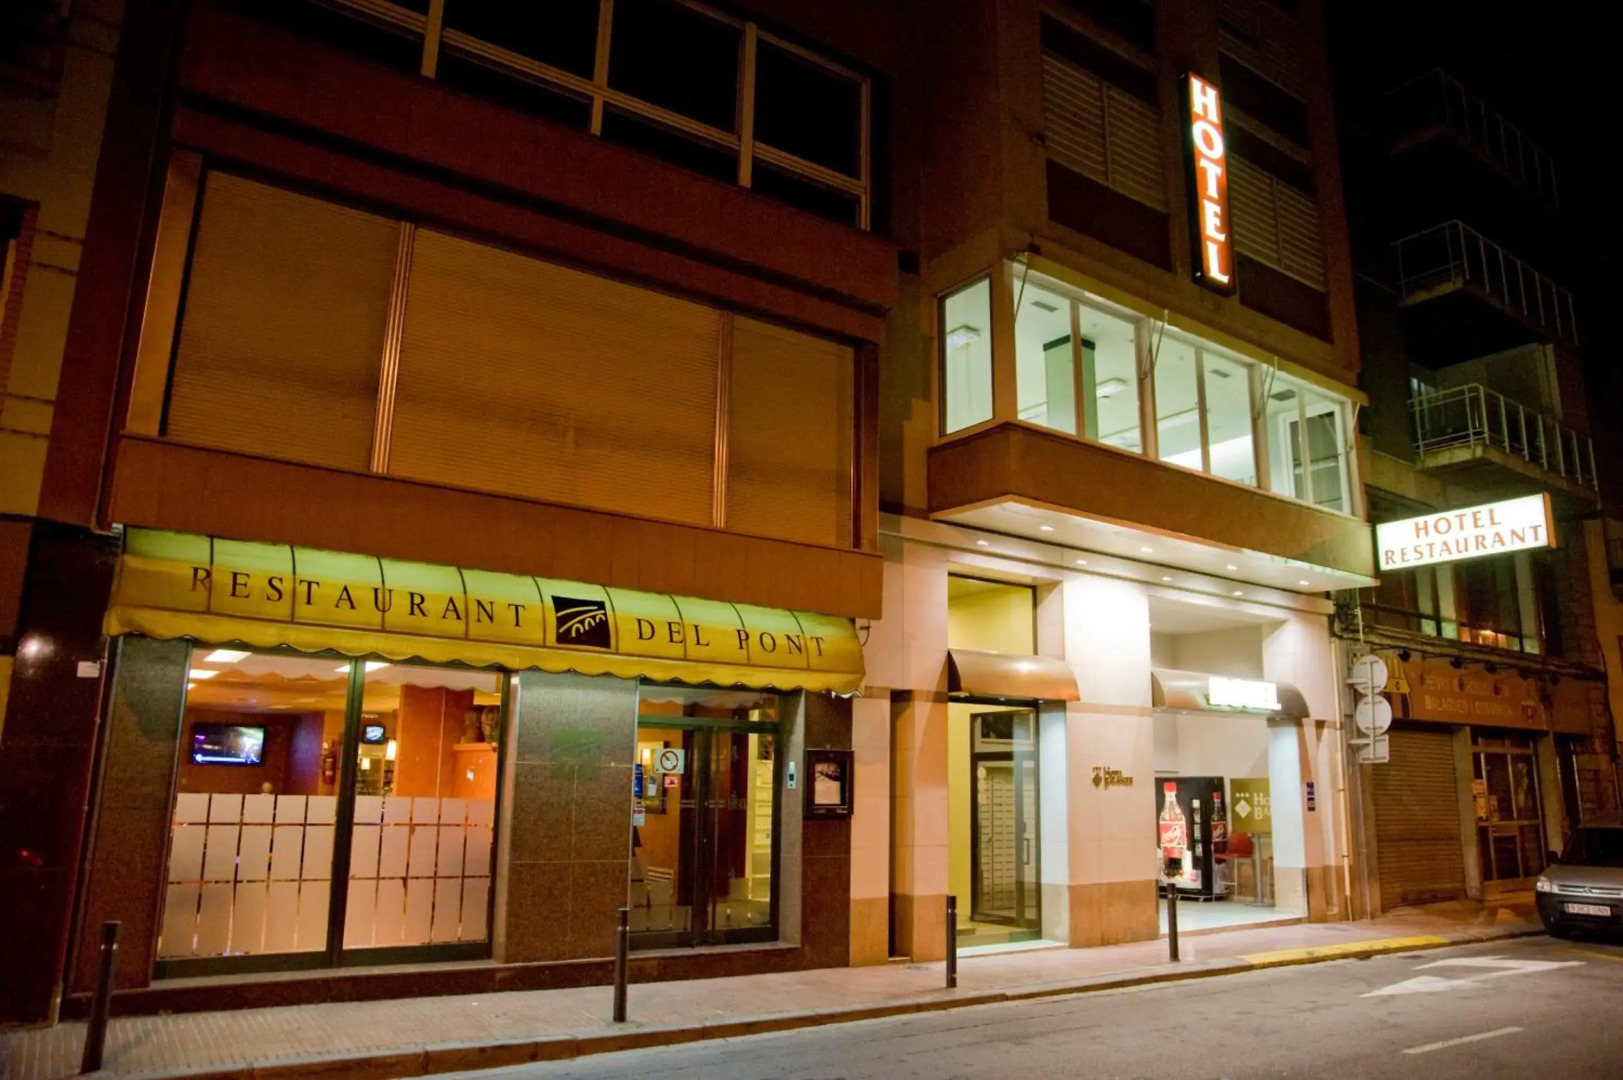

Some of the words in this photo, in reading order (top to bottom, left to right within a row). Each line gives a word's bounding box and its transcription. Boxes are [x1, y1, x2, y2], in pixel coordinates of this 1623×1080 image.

[1190, 77, 1229, 284] HOTEL
[1384, 524, 1542, 566] RESTAURANT
[1414, 508, 1502, 539] HOTEL
[190, 566, 526, 627] RESTAURANT
[636, 618, 710, 647] DEL
[736, 628, 825, 657] PONT
